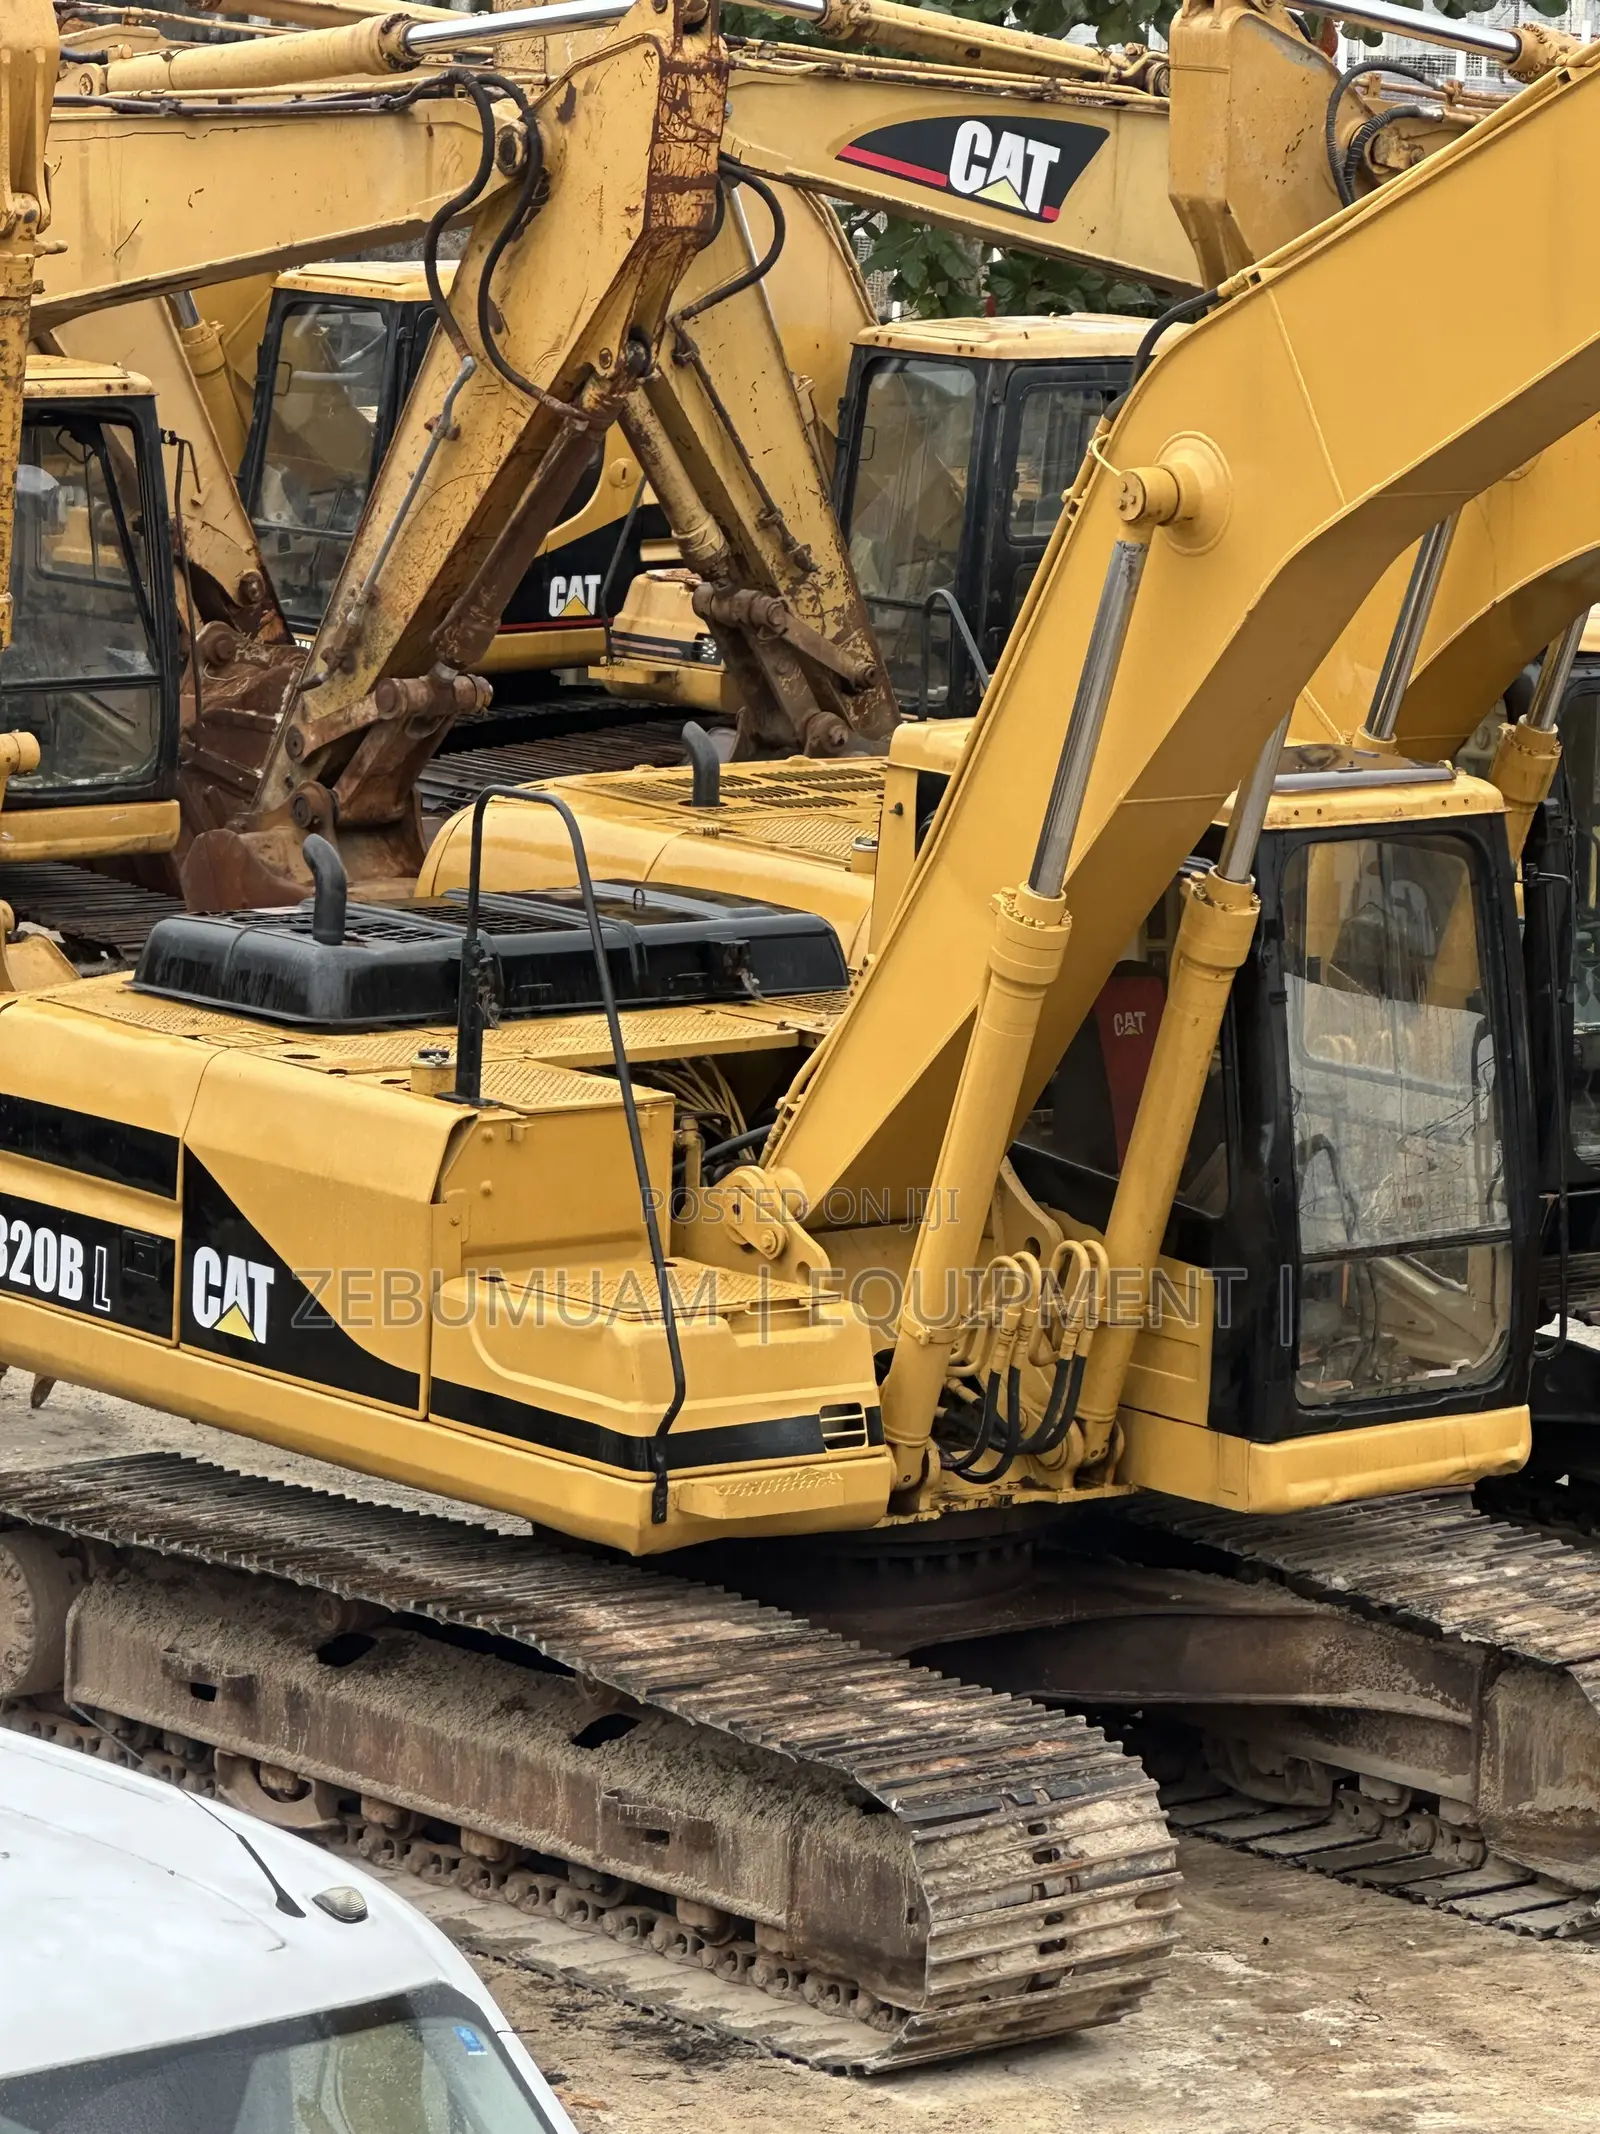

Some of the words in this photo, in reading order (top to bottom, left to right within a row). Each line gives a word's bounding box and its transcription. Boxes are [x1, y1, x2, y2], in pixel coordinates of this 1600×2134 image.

[949, 120, 1061, 214] CAT
[549, 574, 601, 617] CAT
[1113, 1011, 1147, 1037] CAT
[192, 1246, 275, 1344] CAT
